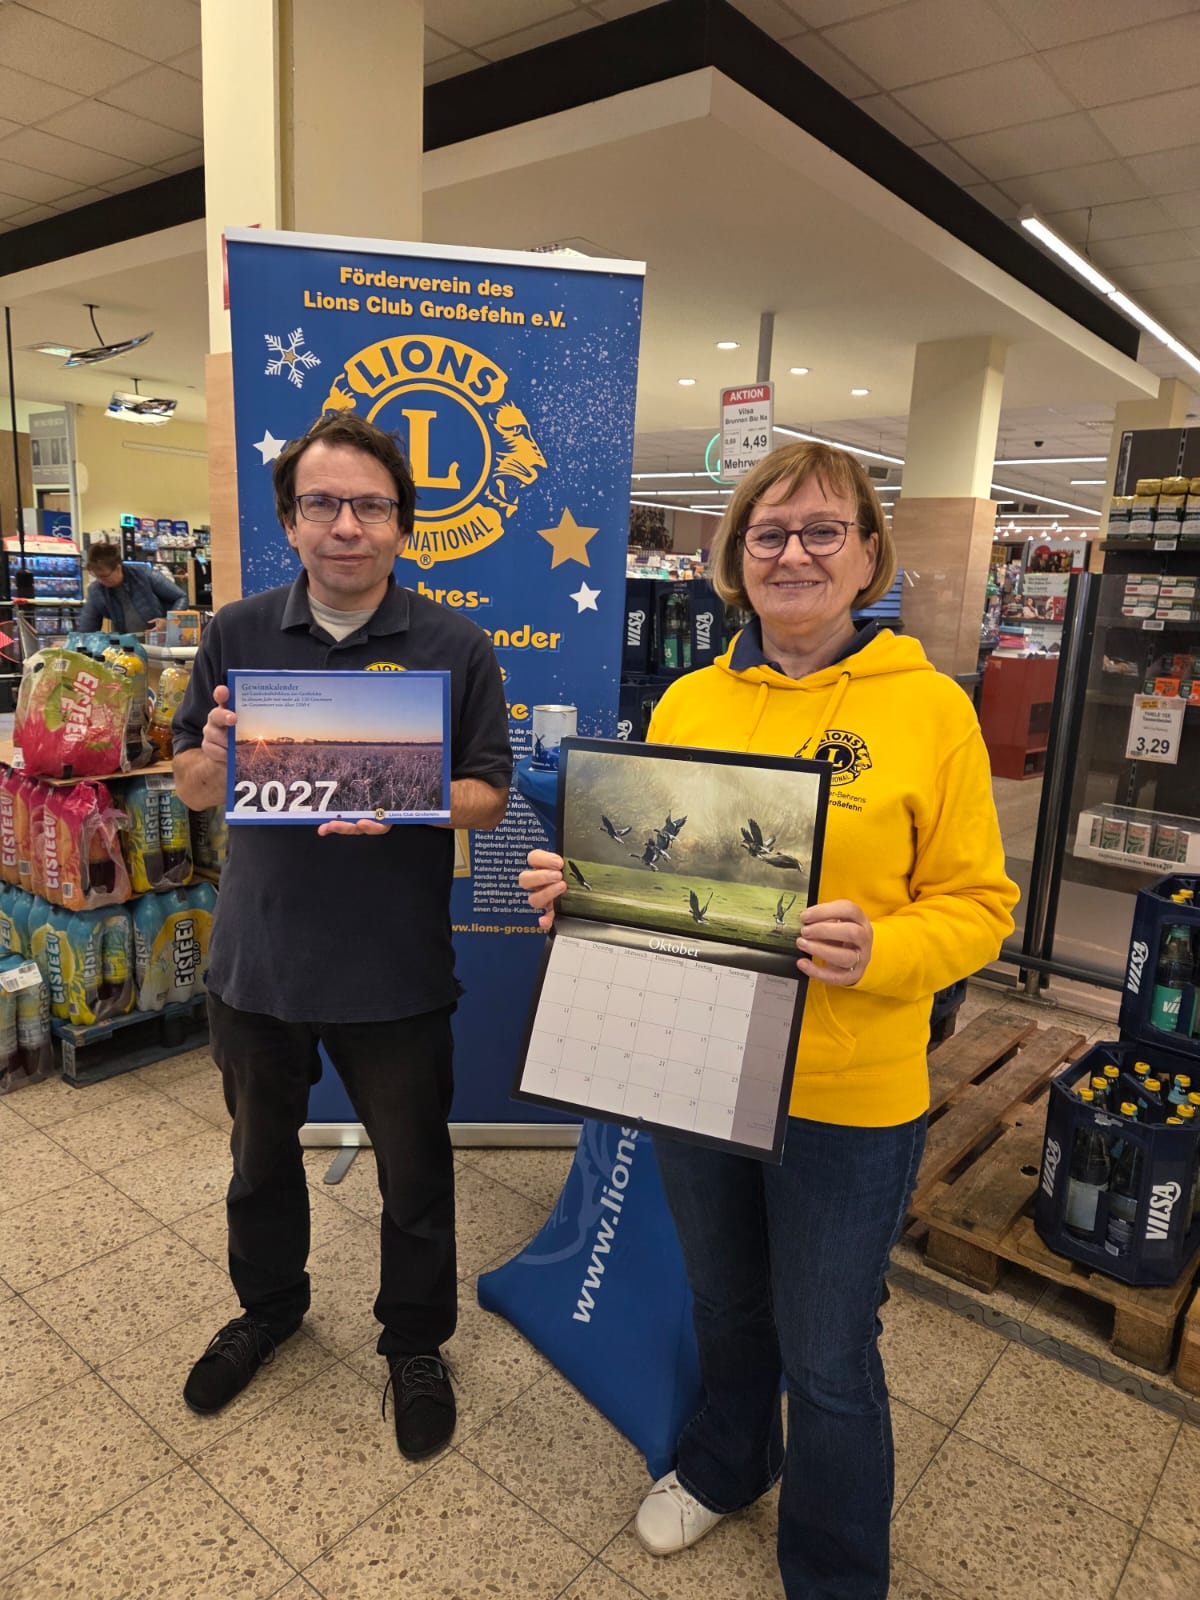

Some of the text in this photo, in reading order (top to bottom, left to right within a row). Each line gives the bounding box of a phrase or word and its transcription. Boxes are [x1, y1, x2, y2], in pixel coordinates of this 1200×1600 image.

[340, 267, 514, 298] Förderverein des
[303, 291, 567, 328] Lions Club Großefehn e.V.
[354, 340, 499, 397] LIONS
[729, 388, 764, 401] AKTION
[401, 408, 461, 490] L
[743, 434, 768, 450] 4,49
[405, 581, 490, 608] hres-
[627, 610, 645, 646] VILSA
[696, 612, 713, 650] VILSA
[821, 732, 861, 746] IONS
[1136, 737, 1170, 755] 3,29
[234, 780, 338, 813] 2027
[649, 937, 699, 957] Oktober
[1127, 941, 1149, 994] VILSA
[1042, 1137, 1061, 1198] VILSA
[1145, 1181, 1182, 1239] VILSA
